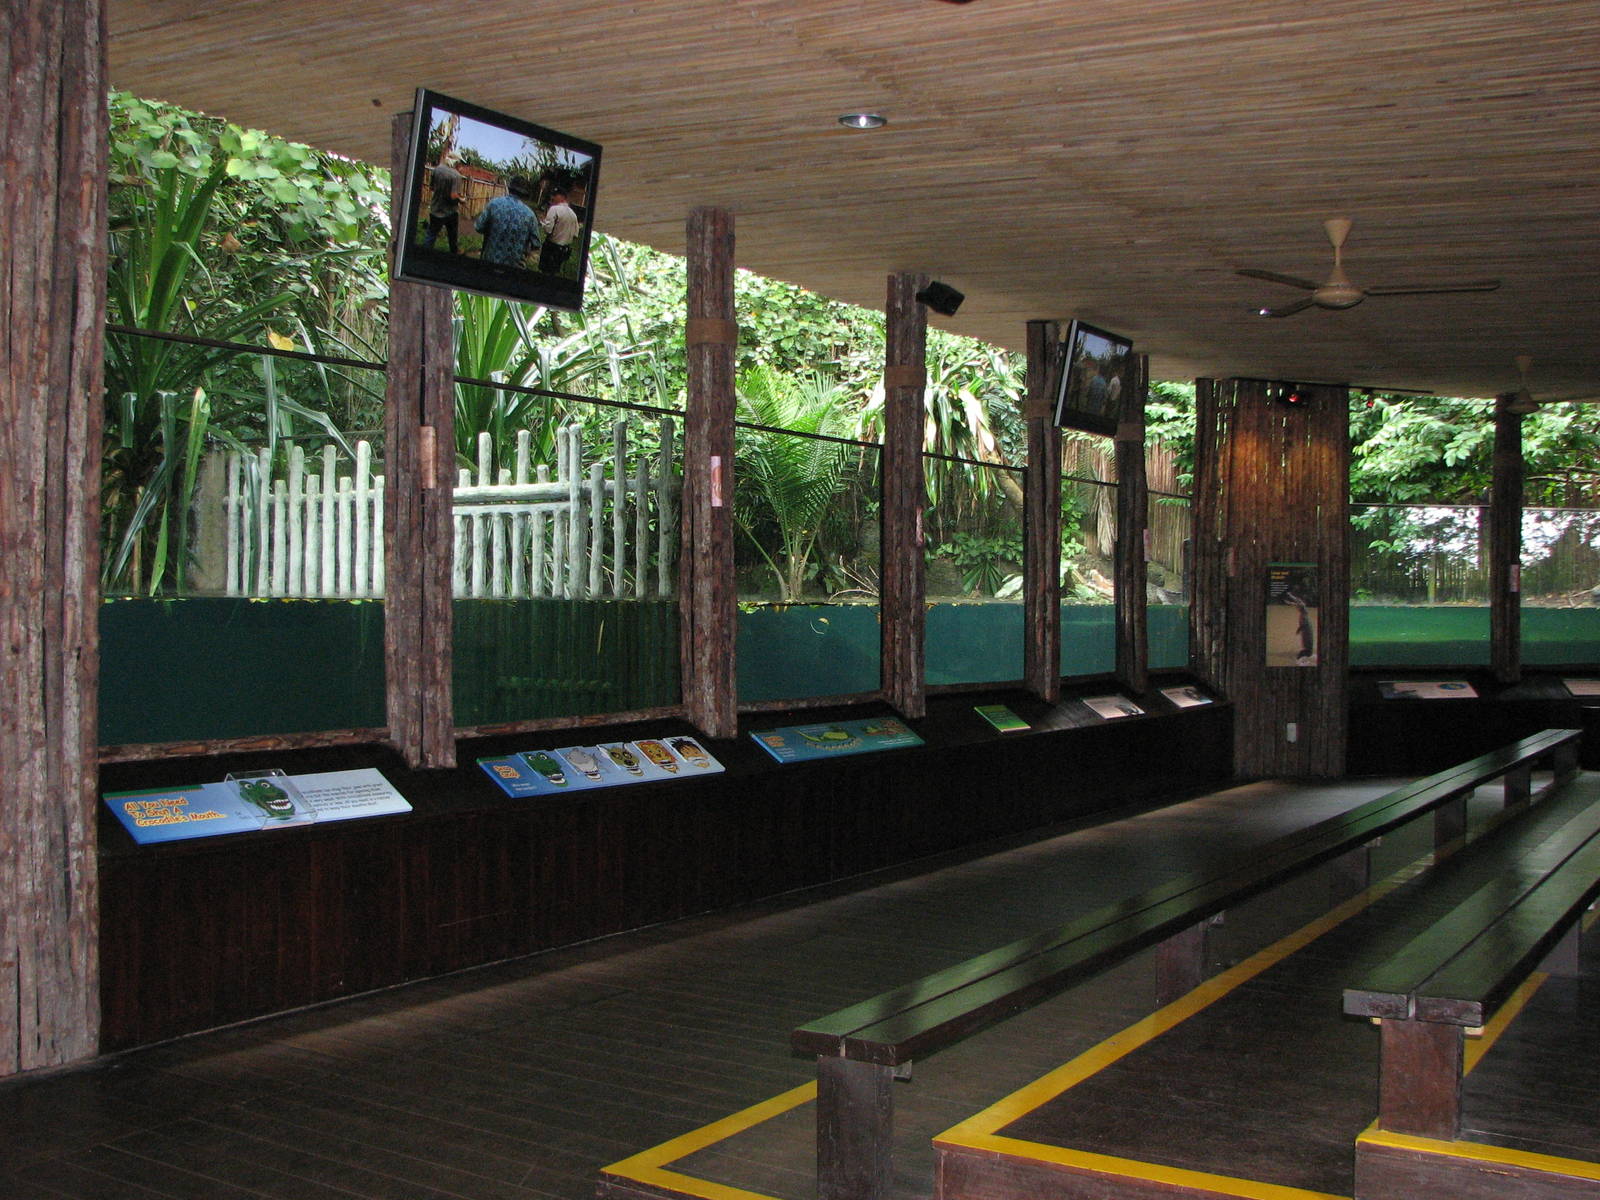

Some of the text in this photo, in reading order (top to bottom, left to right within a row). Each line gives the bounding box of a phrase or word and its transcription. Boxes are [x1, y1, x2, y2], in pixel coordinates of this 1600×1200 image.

[125, 797, 188, 810] All You Need
[147, 808, 169, 817] Shut
[174, 807, 182, 815] A
